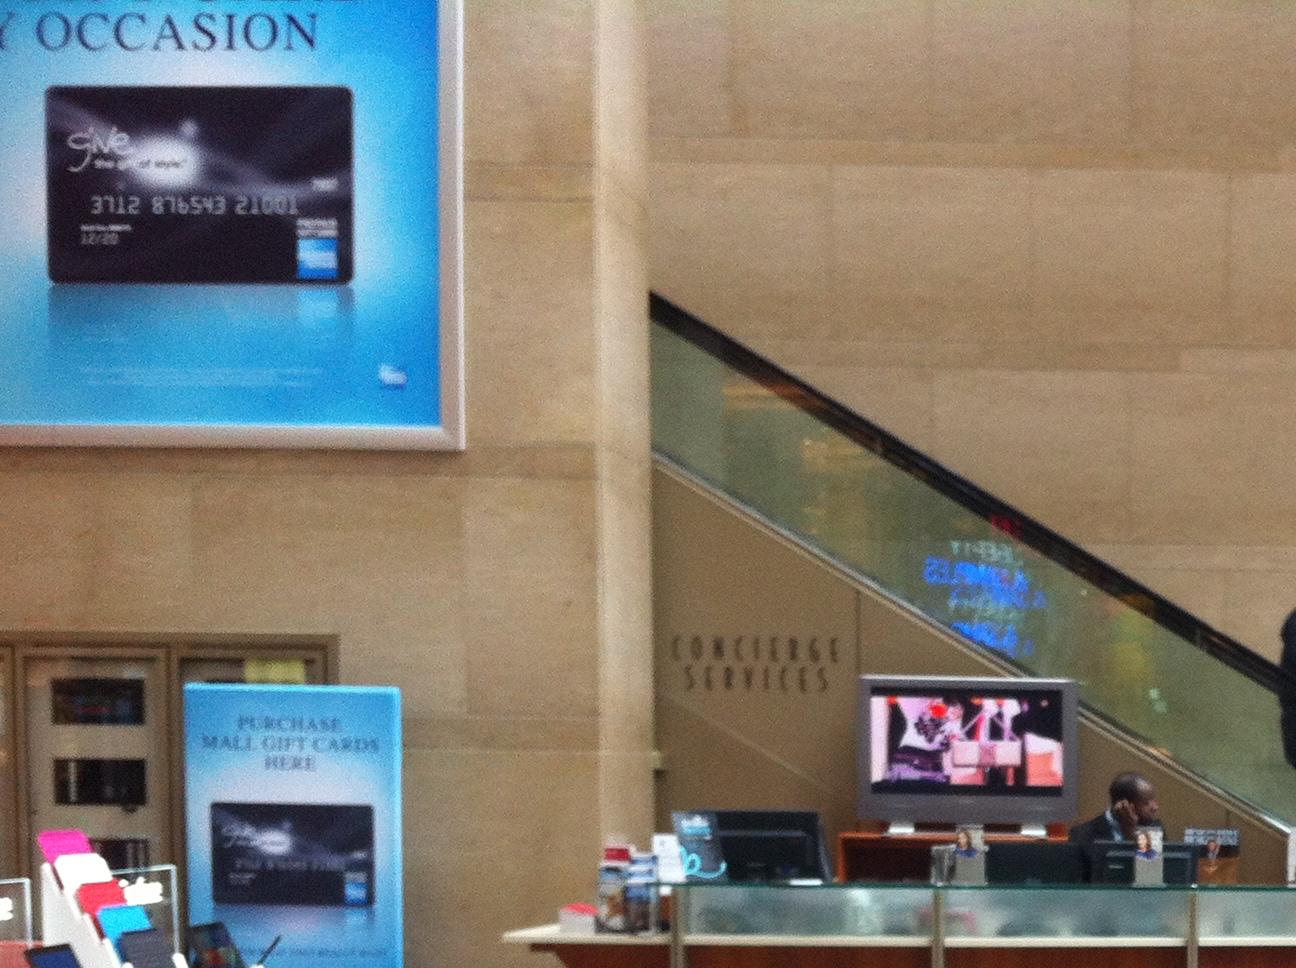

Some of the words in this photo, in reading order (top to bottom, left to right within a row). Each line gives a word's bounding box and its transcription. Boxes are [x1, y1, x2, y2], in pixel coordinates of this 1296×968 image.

[35, 12, 319, 52] OCCASION
[90, 195, 140, 215] 3712
[670, 635, 841, 664] CONCIERGE
[683, 666, 829, 692] SERVICES
[237, 715, 344, 733] PURCHASE
[201, 733, 255, 753] MALL
[261, 735, 307, 754] GIFT
[311, 737, 381, 755] CARDS
[264, 754, 317, 773] HERE
